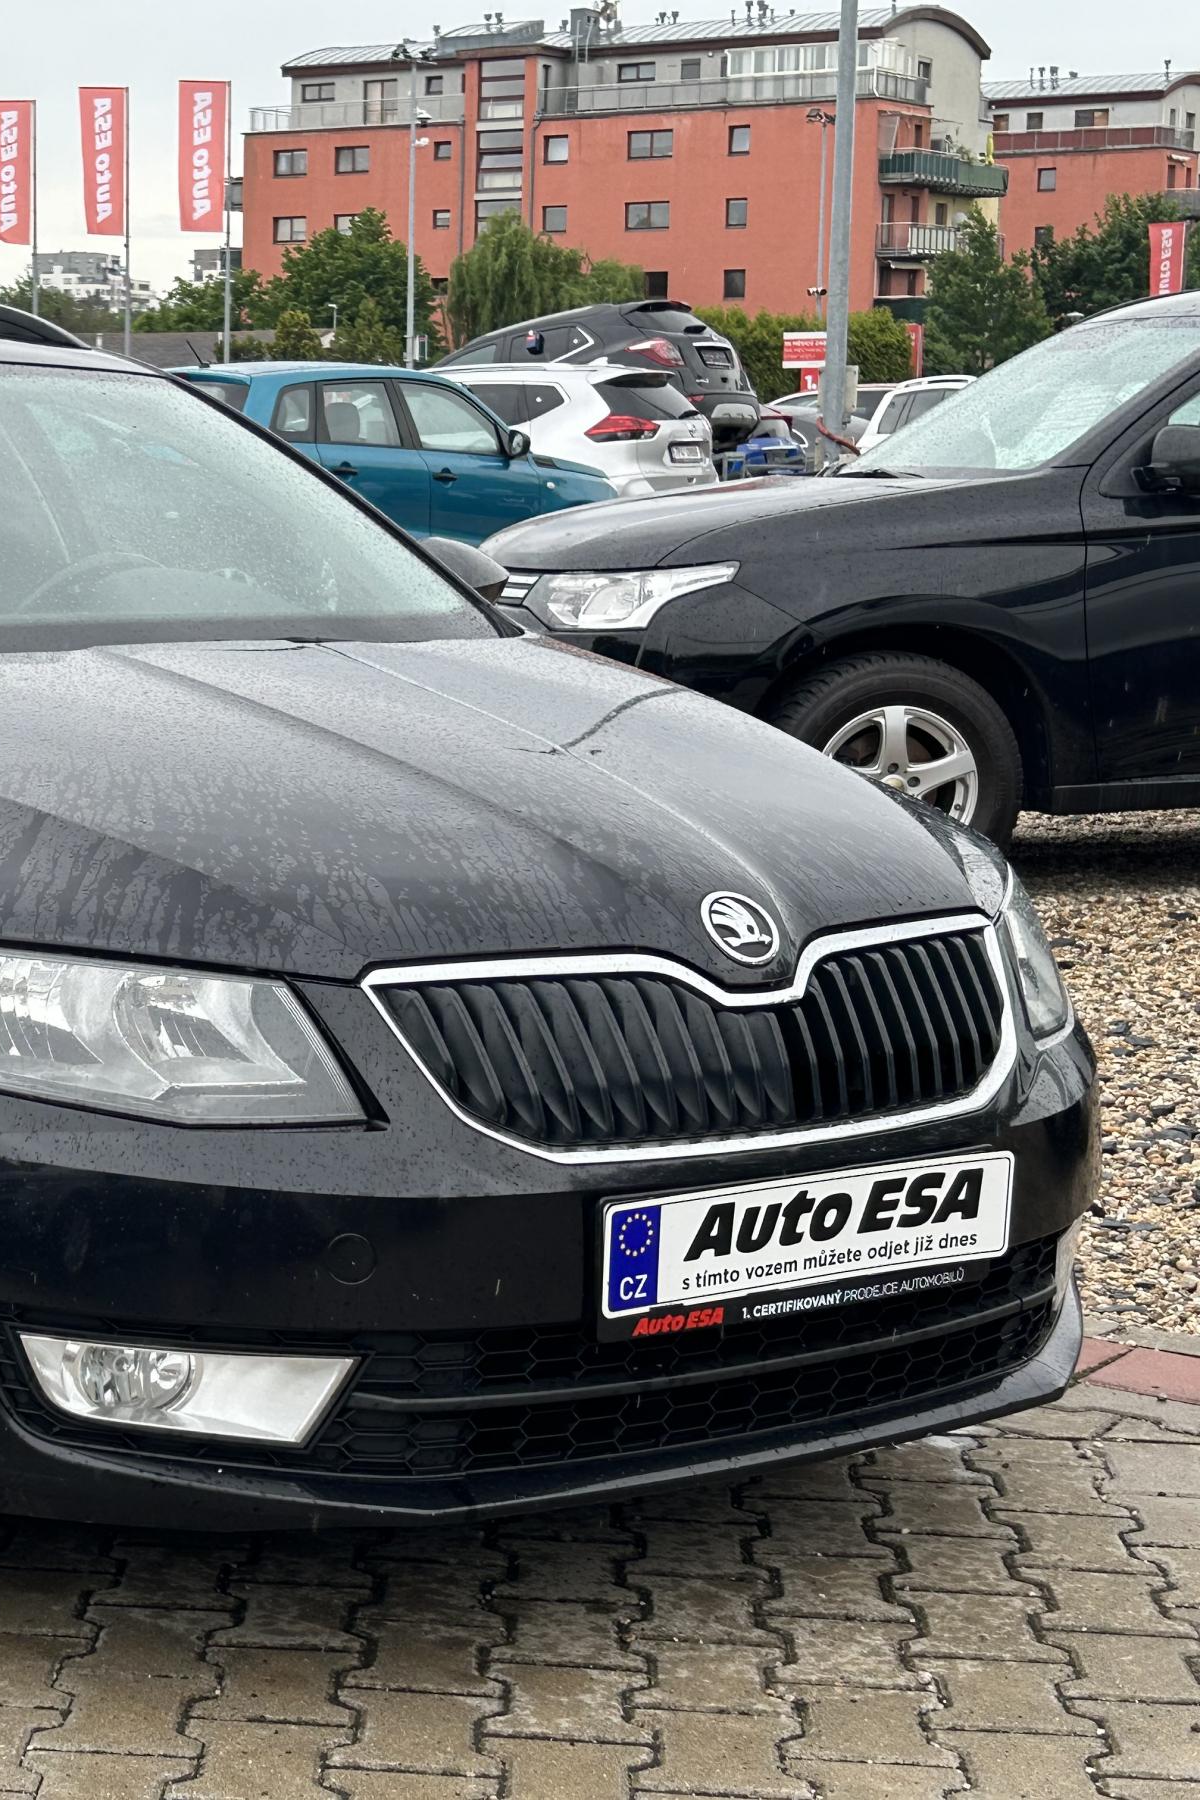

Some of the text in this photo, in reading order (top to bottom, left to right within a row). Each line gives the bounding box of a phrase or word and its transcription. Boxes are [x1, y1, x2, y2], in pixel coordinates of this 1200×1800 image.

[683, 1167, 984, 1262] Auto ESA
[620, 1274, 648, 1301] CZ
[682, 1233, 978, 1290] s tímto vozem můžete odjet již dnes
[684, 1307, 724, 1330] ESA
[742, 1267, 965, 1319] 1. CERTIFIKOVANÝ PRODEJCE AUTOMOBILŮ
